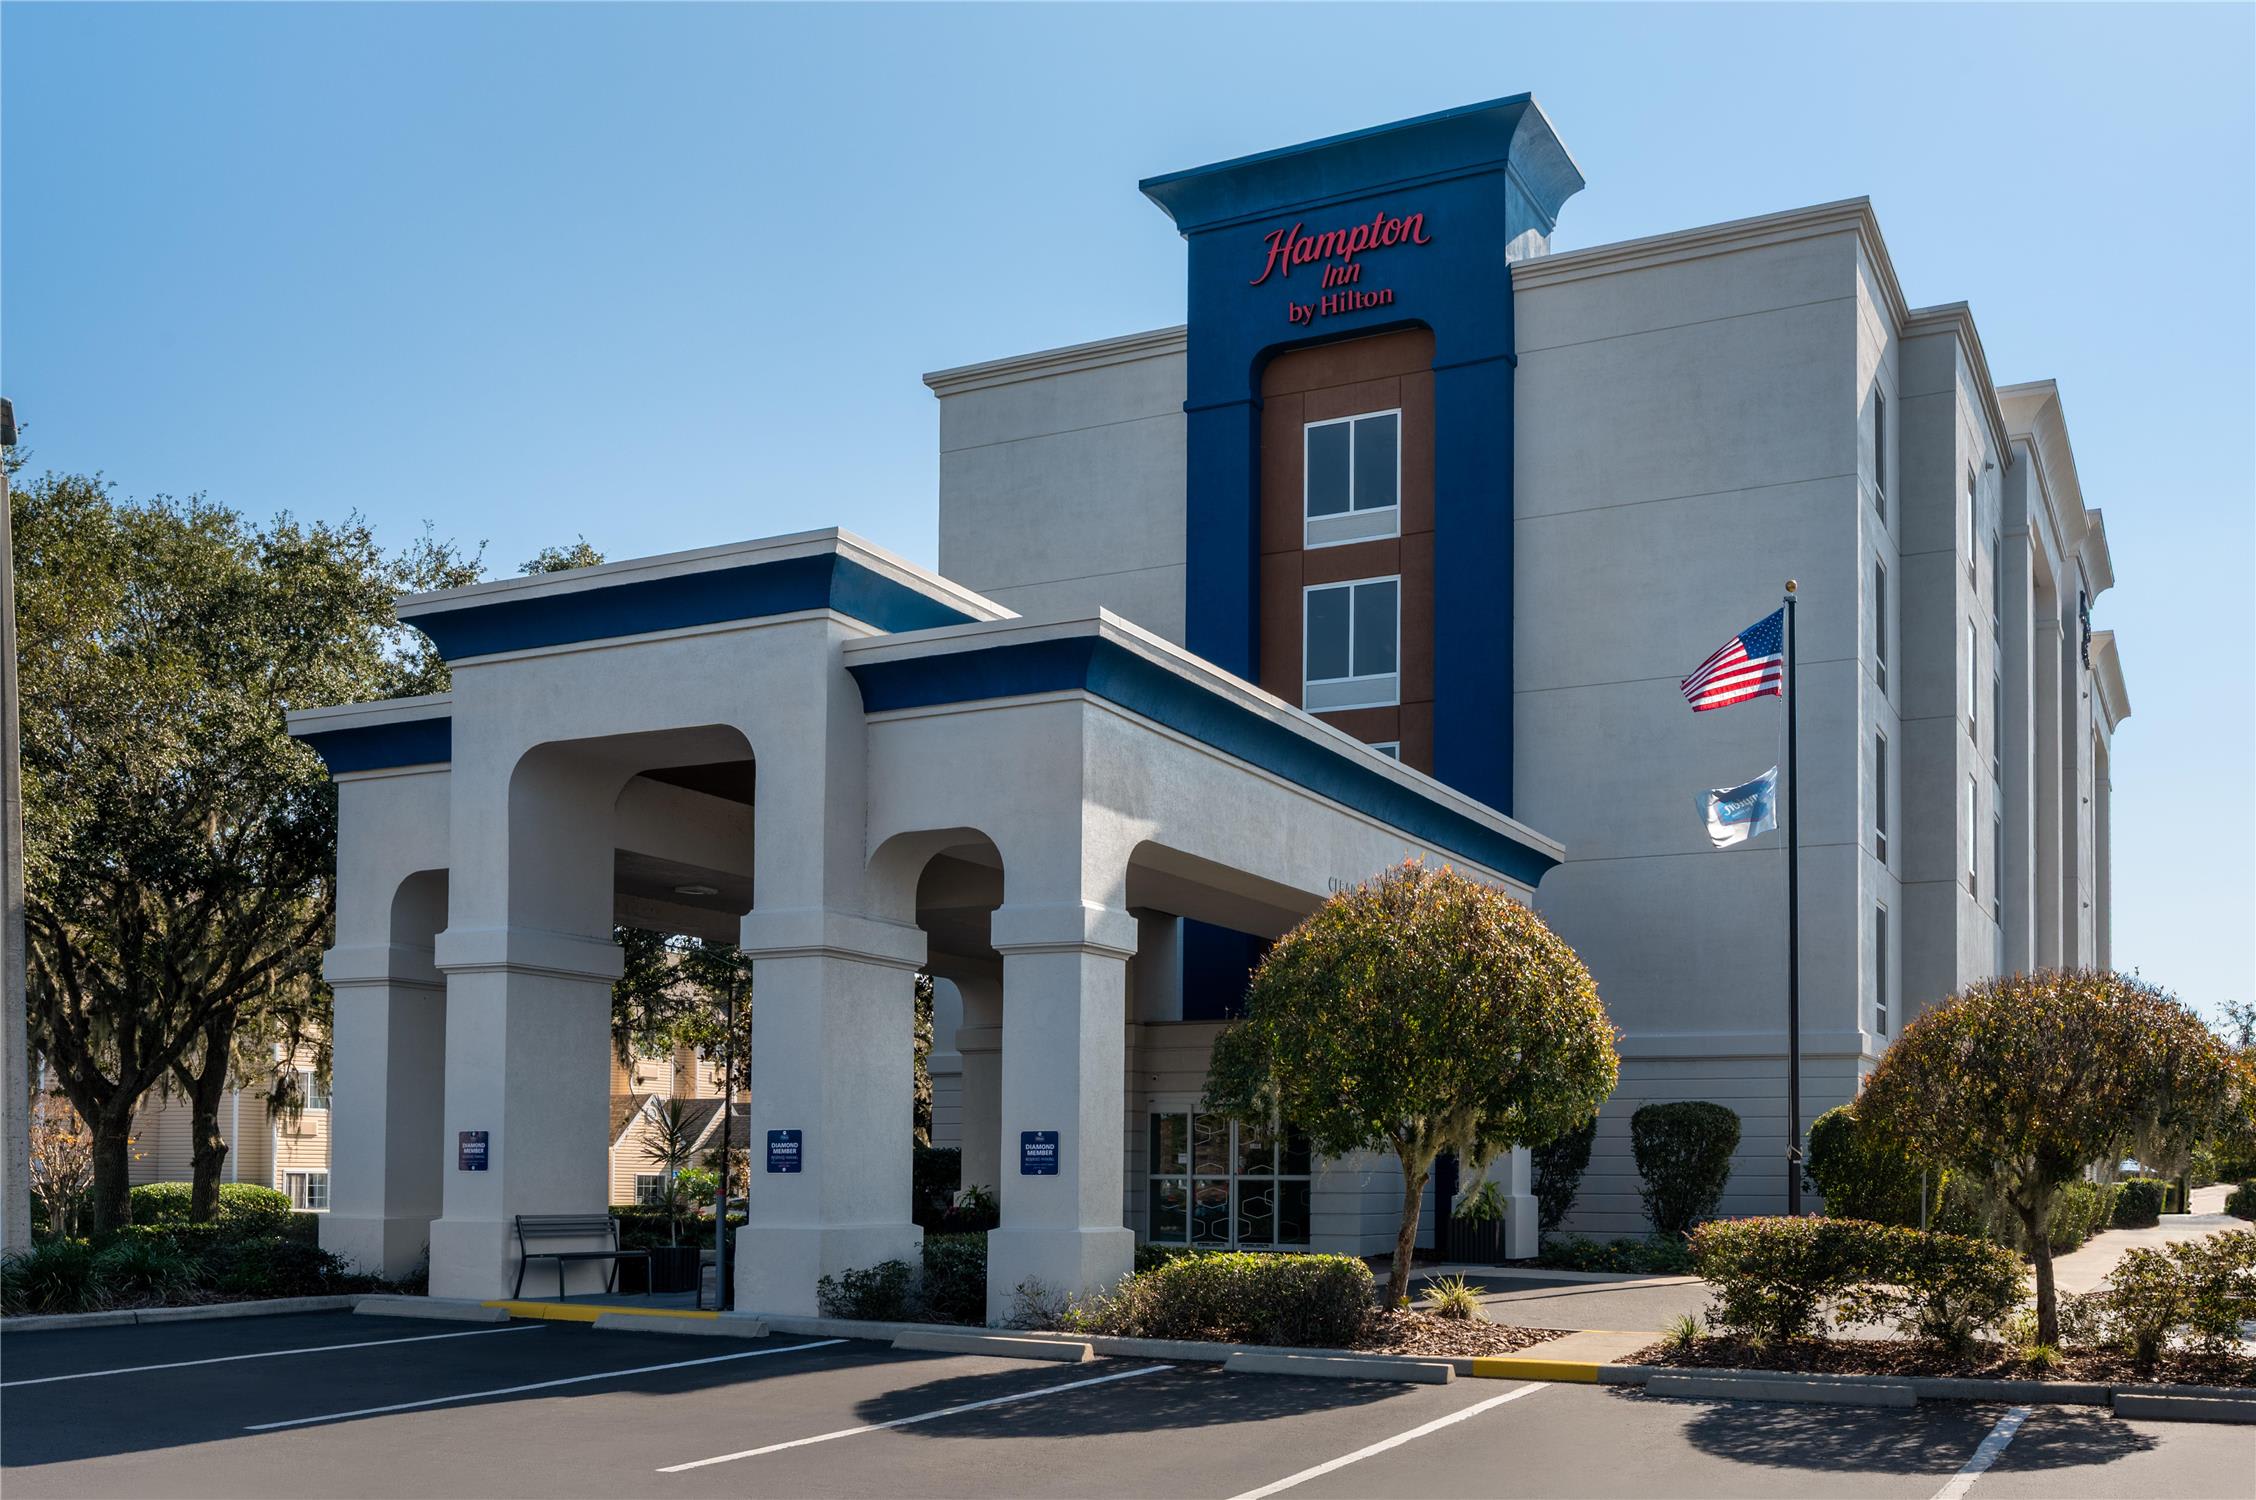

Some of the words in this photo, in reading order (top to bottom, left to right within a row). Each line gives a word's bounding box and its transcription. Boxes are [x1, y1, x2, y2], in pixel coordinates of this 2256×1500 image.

[1248, 211, 1432, 286] Hampton
[1321, 263, 1361, 289] Inn
[1288, 302, 1316, 326] by
[1320, 288, 1393, 316] Hilton
